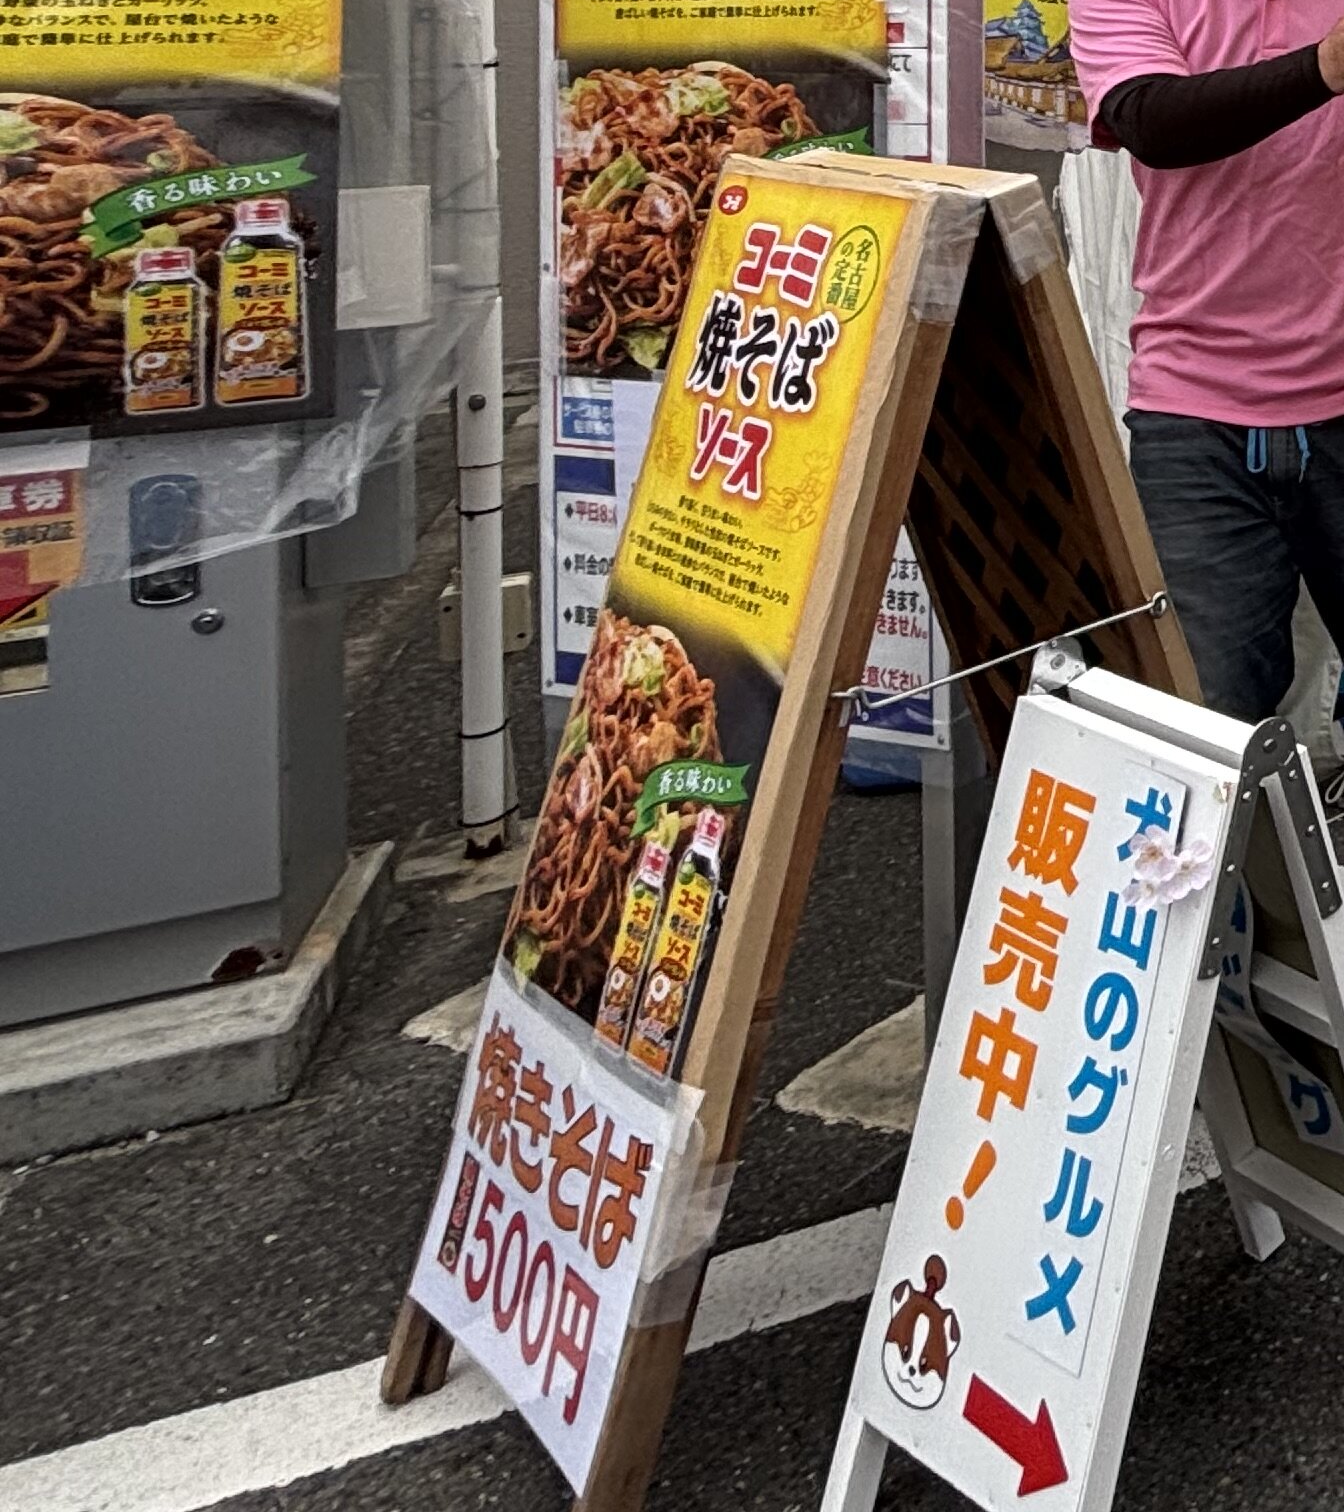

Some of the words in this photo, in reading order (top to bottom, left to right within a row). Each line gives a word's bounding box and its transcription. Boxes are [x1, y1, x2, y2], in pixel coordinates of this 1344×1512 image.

[129, 169, 283, 212] 香る味わい
[143, 295, 188, 309] コーミ
[237, 262, 289, 279] コーミ
[736, 225, 831, 305] コーミ
[844, 238, 872, 312] 名古屋
[239, 301, 287, 316] ソース
[689, 296, 836, 410] 焼そば
[693, 404, 770, 497] ソース
[574, 553, 616, 577] 料金の
[880, 589, 927, 616] きます。
[945, 768, 1099, 1231] 販売中!
[469, 1009, 655, 1271] 焼きそば
[463, 1179, 601, 1427] 500円
